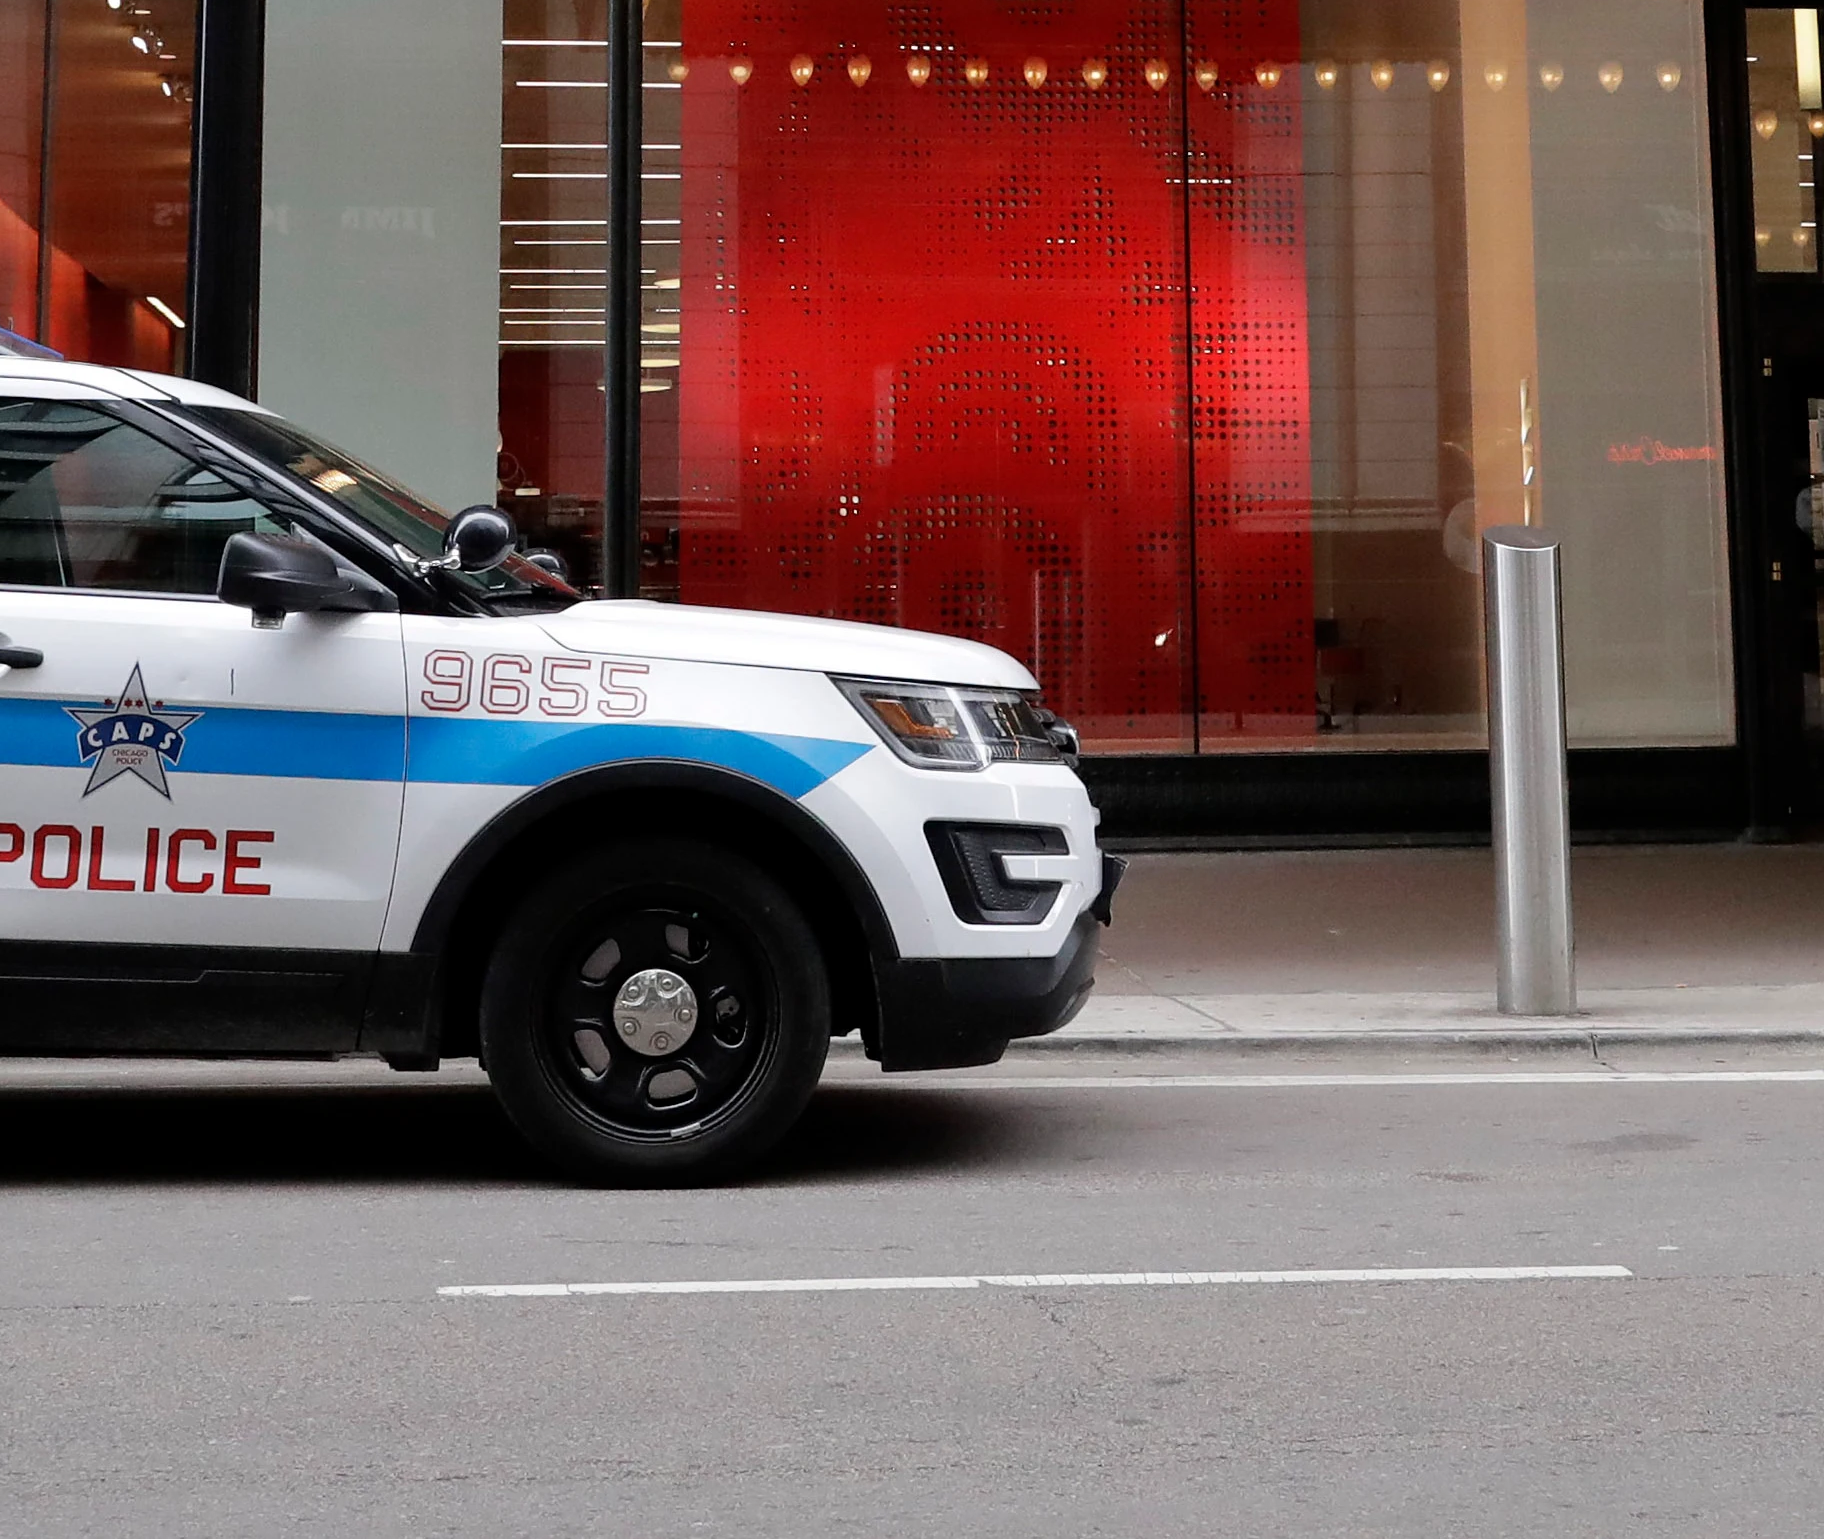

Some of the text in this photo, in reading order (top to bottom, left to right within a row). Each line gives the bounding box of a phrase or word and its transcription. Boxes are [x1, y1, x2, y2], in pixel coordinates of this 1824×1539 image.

[421, 649, 650, 718] 9655
[87, 721, 177, 750] CAPS
[112, 749, 149, 757] CHICAGO
[116, 757, 143, 765] POLICE
